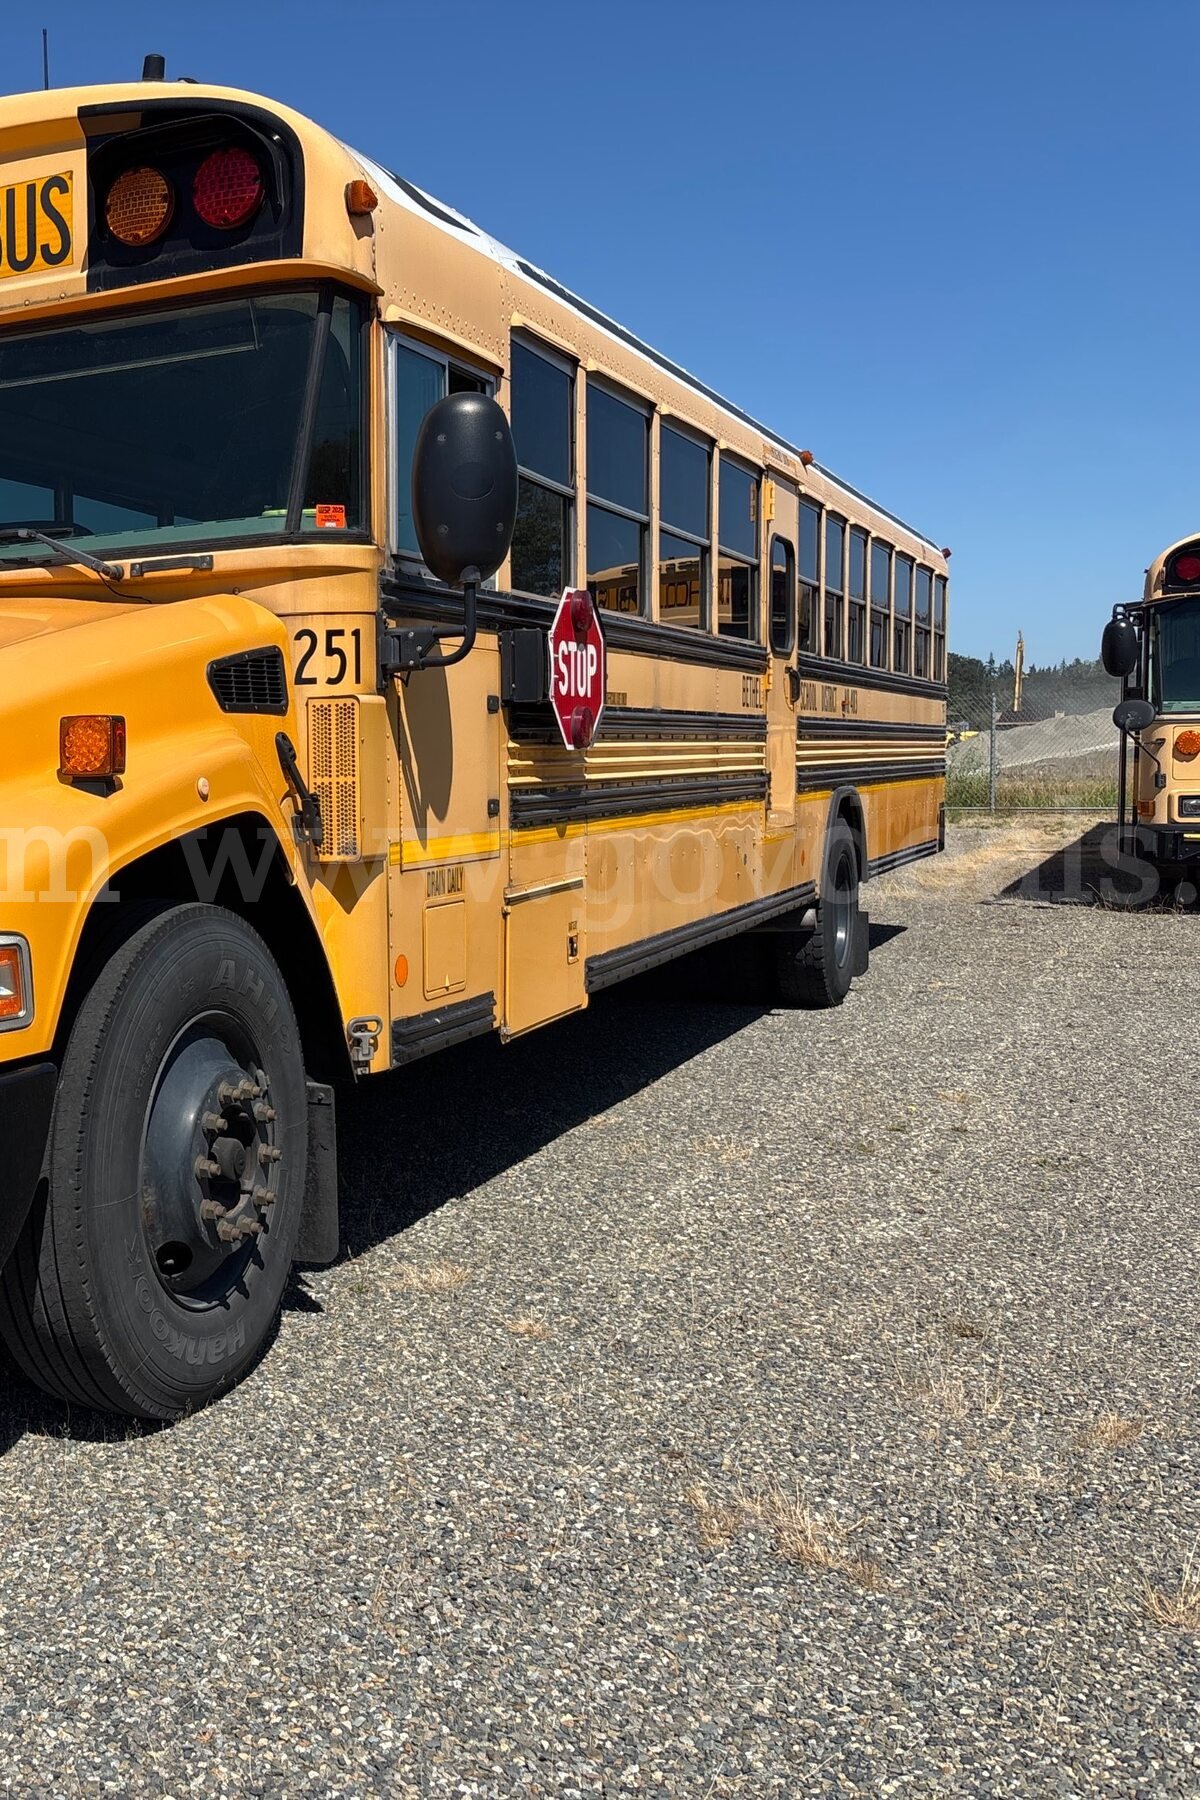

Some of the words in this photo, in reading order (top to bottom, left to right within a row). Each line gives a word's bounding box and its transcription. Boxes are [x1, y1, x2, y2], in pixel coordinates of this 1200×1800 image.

[294, 628, 362, 686] 251
[558, 640, 597, 698] STOP
[800, 681, 817, 711] SCHOOL
[426, 868, 446, 898] DRAIN
[447, 866, 464, 893] DAILY
